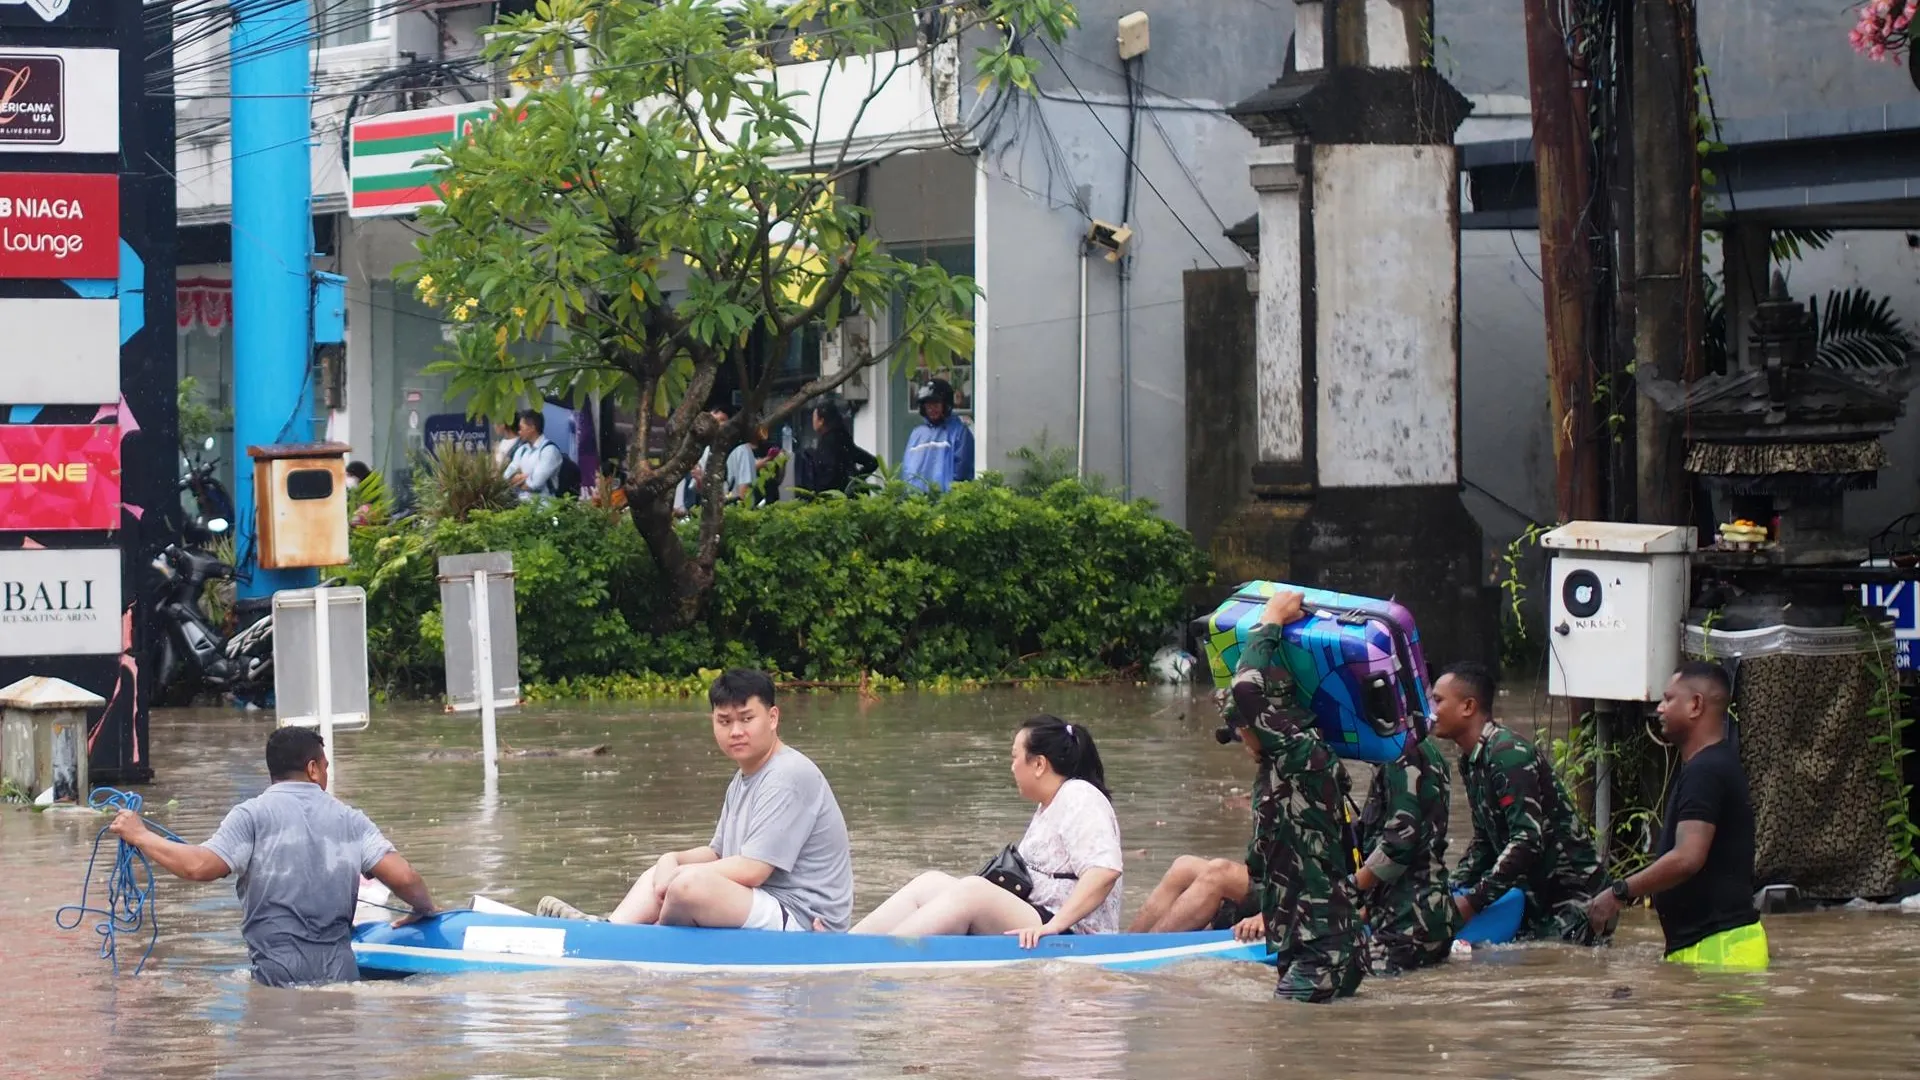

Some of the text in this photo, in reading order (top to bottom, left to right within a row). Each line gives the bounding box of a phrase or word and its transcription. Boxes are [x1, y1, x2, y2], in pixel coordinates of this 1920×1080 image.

[33, 113, 54, 123] USA
[16, 197, 84, 219] NIAGA
[3, 226, 84, 259] Lounge
[3, 580, 95, 611] BALI
[20, 613, 63, 622] SKATING
[66, 612, 98, 621] ARENA
